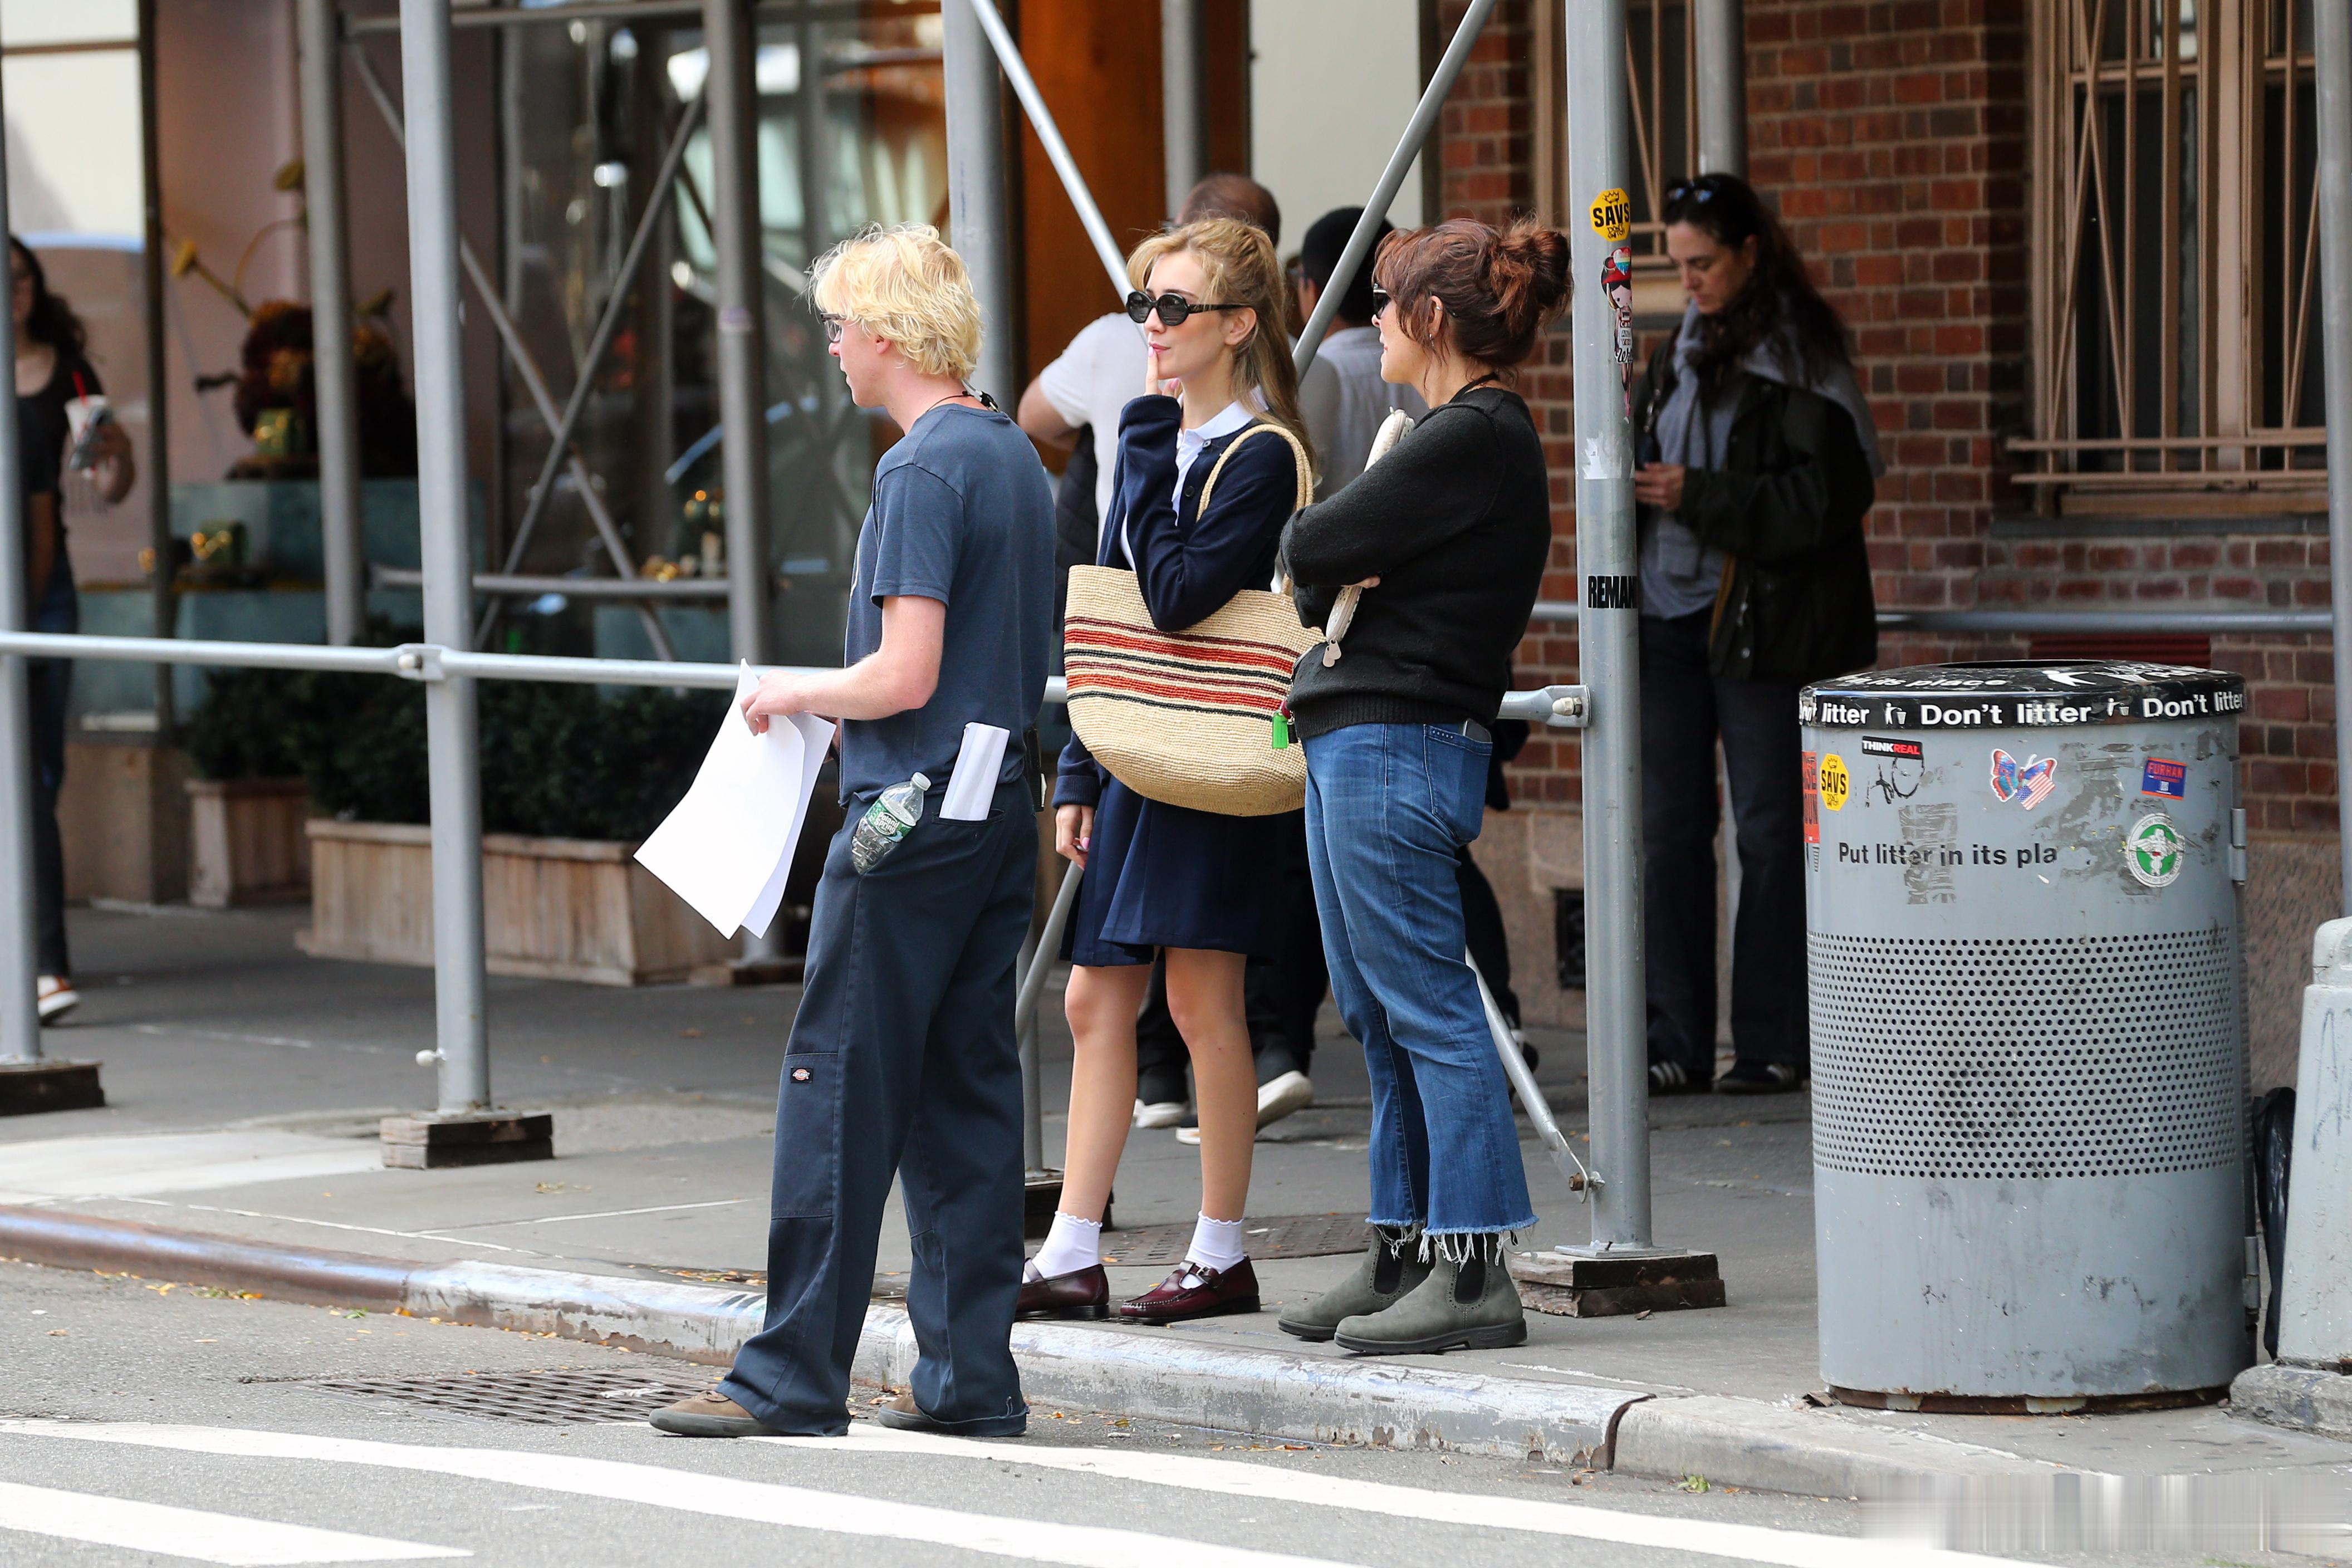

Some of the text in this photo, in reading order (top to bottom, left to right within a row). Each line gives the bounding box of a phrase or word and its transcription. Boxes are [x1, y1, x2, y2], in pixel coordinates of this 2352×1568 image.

[1593, 203, 1630, 227] SAVS
[1821, 703, 1870, 724] litter
[1921, 704, 2003, 725] Don't
[2016, 703, 2092, 724] litter
[2143, 694, 2209, 718] Don't
[2213, 691, 2243, 712] litter
[1821, 770, 1846, 795] SAVS
[874, 818, 896, 834] Spring
[878, 811, 900, 828] Poland
[1839, 842, 1869, 864] Put
[1941, 845, 1963, 866] in
[1973, 844, 2007, 865] its
